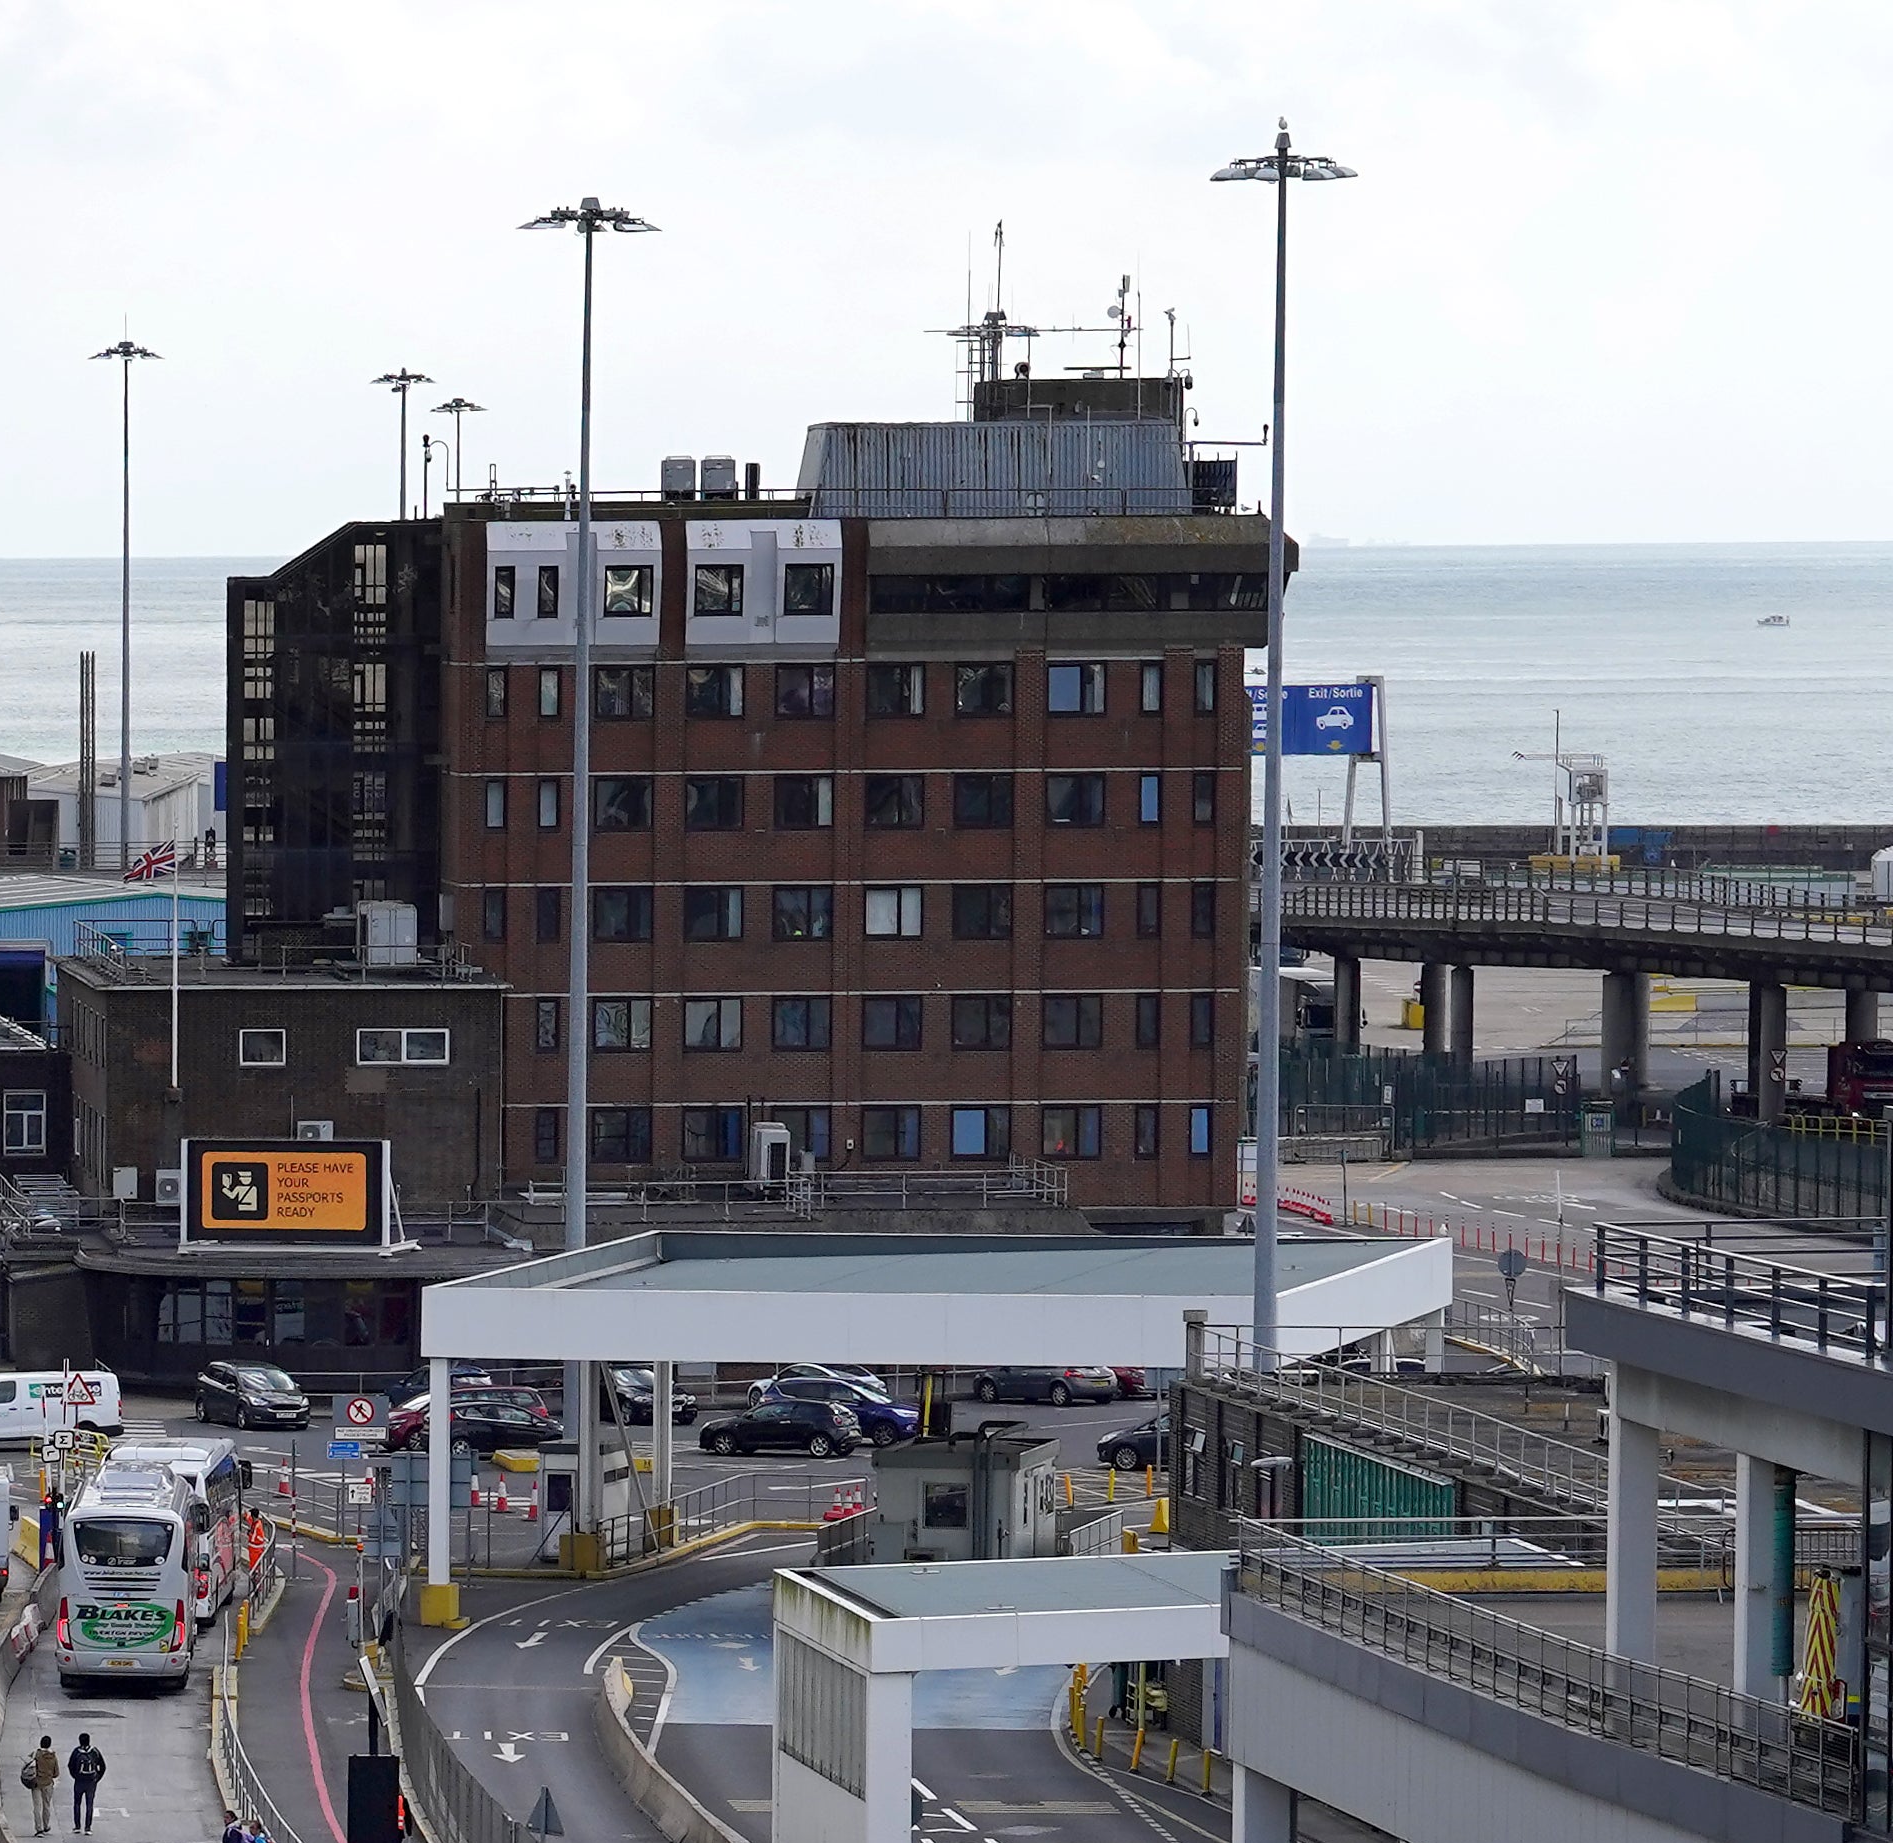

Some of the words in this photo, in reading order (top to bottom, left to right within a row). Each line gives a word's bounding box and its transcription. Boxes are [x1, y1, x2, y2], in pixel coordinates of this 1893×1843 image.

[1308, 687, 1363, 700] Exit/Sortie
[277, 1162, 320, 1174] PLEASE
[324, 1162, 354, 1174] HAVE
[277, 1177, 310, 1188] YOUR
[277, 1192, 344, 1204] PASSPORTS
[277, 1207, 315, 1218] READY
[75, 1604, 169, 1621] BLAKES
